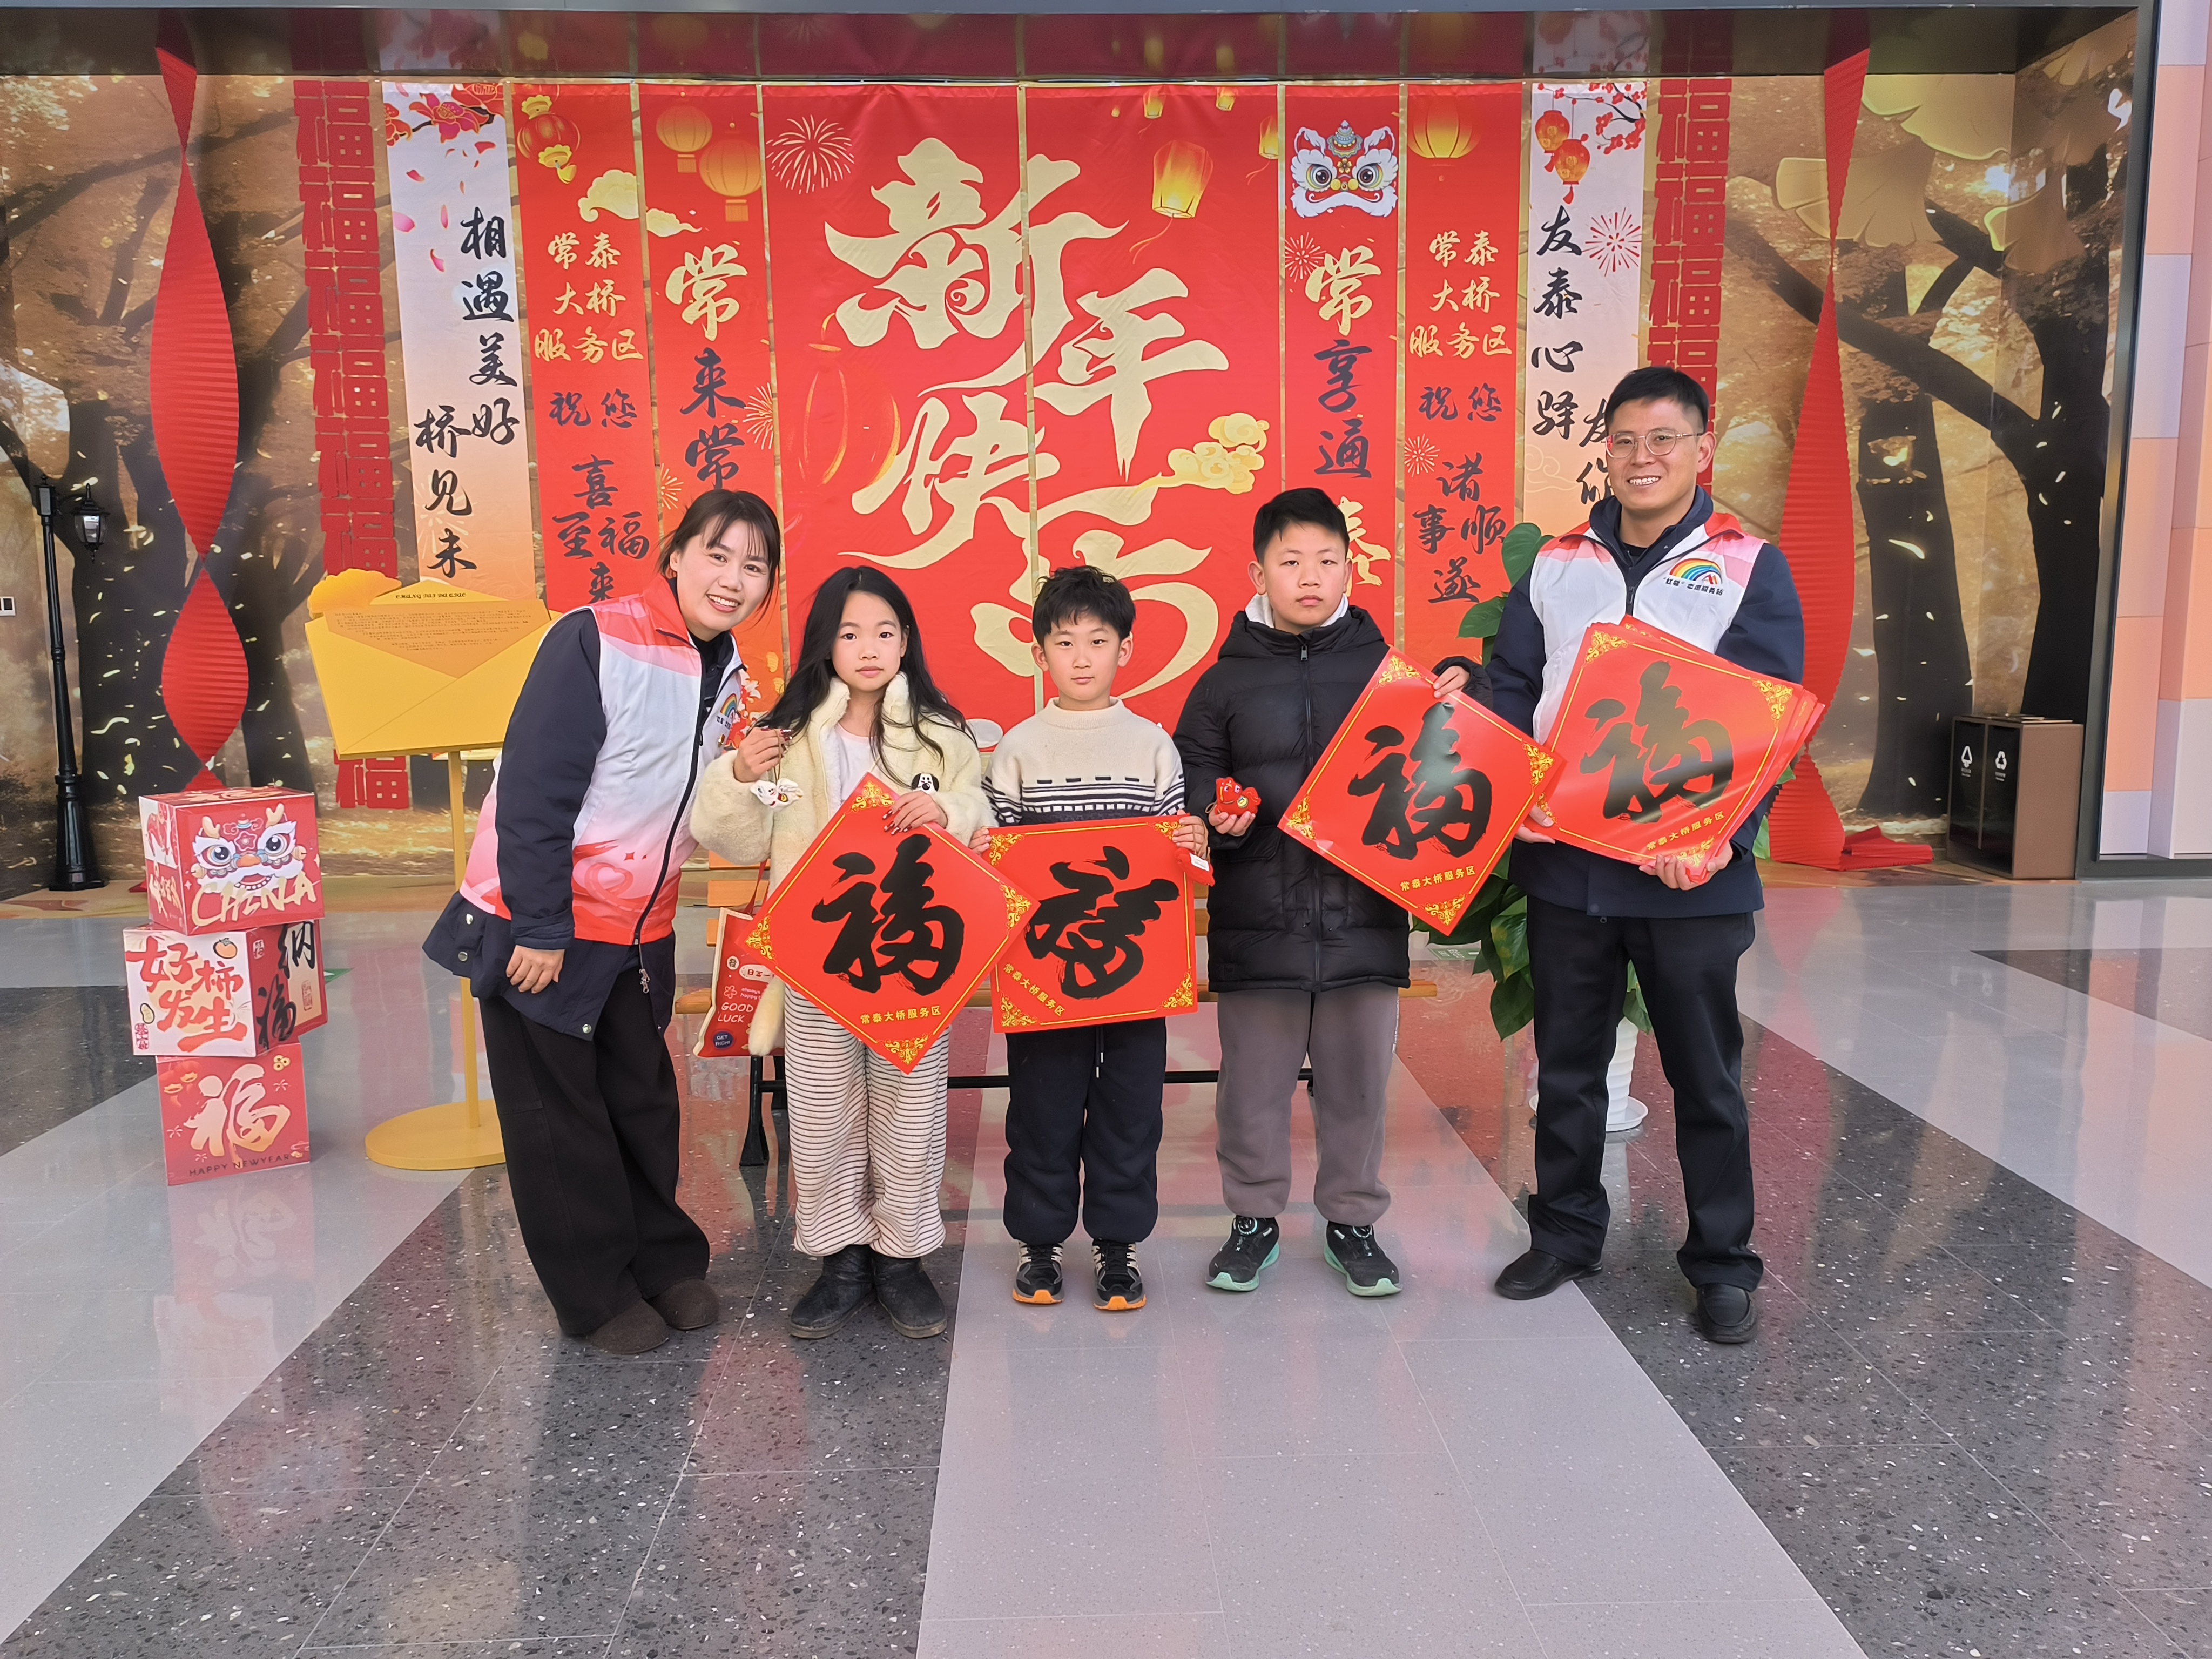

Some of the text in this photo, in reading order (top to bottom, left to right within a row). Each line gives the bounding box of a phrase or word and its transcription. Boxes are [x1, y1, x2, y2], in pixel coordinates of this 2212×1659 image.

[548, 232, 621, 269] 常泰
[1429, 230, 1499, 267] 常泰
[552, 279, 626, 317] 大桥
[1429, 276, 1500, 313] 大桥
[460, 207, 520, 446] 相遇美好
[1409, 321, 1512, 359] 服务区
[1531, 205, 1583, 440] 友泰心驿
[534, 326, 644, 364] 服务区
[665, 244, 748, 489] 常来常
[549, 388, 638, 428] 祝您
[1418, 382, 1502, 422] 祝您
[1579, 660, 1734, 824] 福
[1348, 701, 1492, 860] 福
[1647, 811, 1725, 852] 常泰大桥服务区
[191, 869, 318, 927] CHINA
[1399, 865, 1476, 893] 常泰大桥服务区
[812, 833, 965, 996] 福
[1025, 846, 1179, 1000] 福
[125, 935, 244, 1000] 好柿
[721, 1002, 754, 1013] GOOD
[1003, 963, 1065, 1017] 常泰大桥服务区
[157, 989, 248, 1053] 发生
[717, 1013, 745, 1023] LUCK
[860, 1005, 942, 1026] 常泰大桥服务区
[184, 1064, 291, 1169] 福
[189, 1164, 228, 1176] HAPPY
